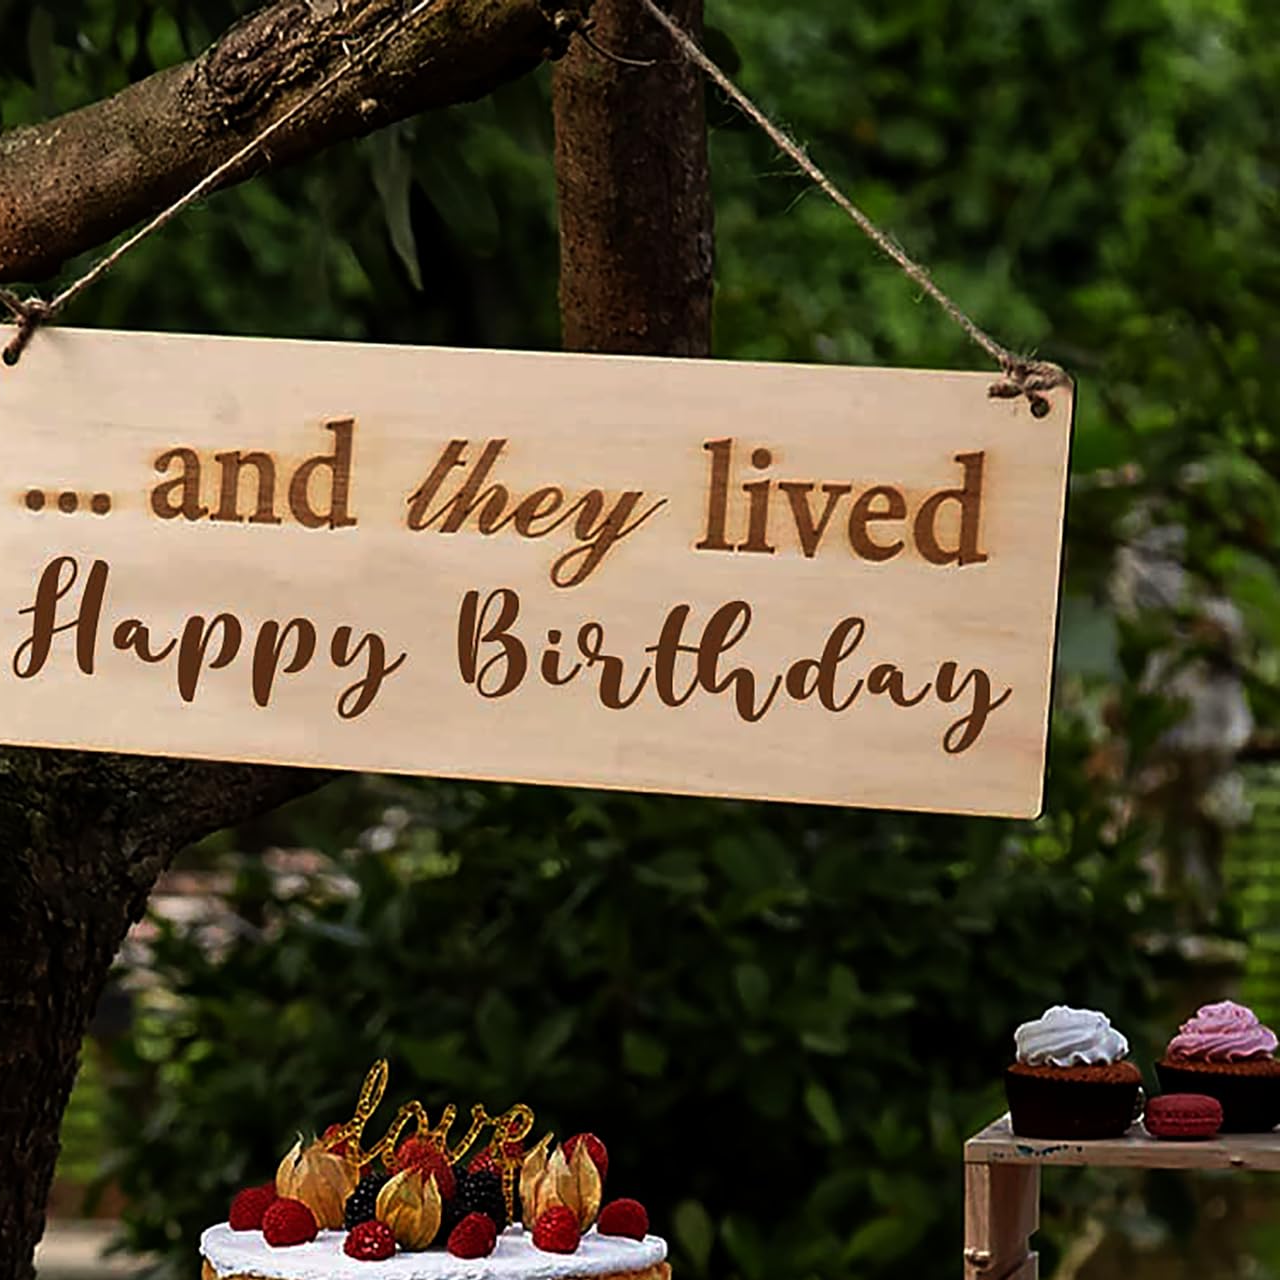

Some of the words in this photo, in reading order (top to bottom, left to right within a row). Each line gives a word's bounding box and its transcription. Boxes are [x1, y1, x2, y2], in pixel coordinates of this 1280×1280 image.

[149, 418, 359, 530] and
[405, 438, 669, 589] they
[696, 437, 990, 569] lived
[12, 556, 407, 720] Happy
[456, 588, 1013, 755] Birthday
